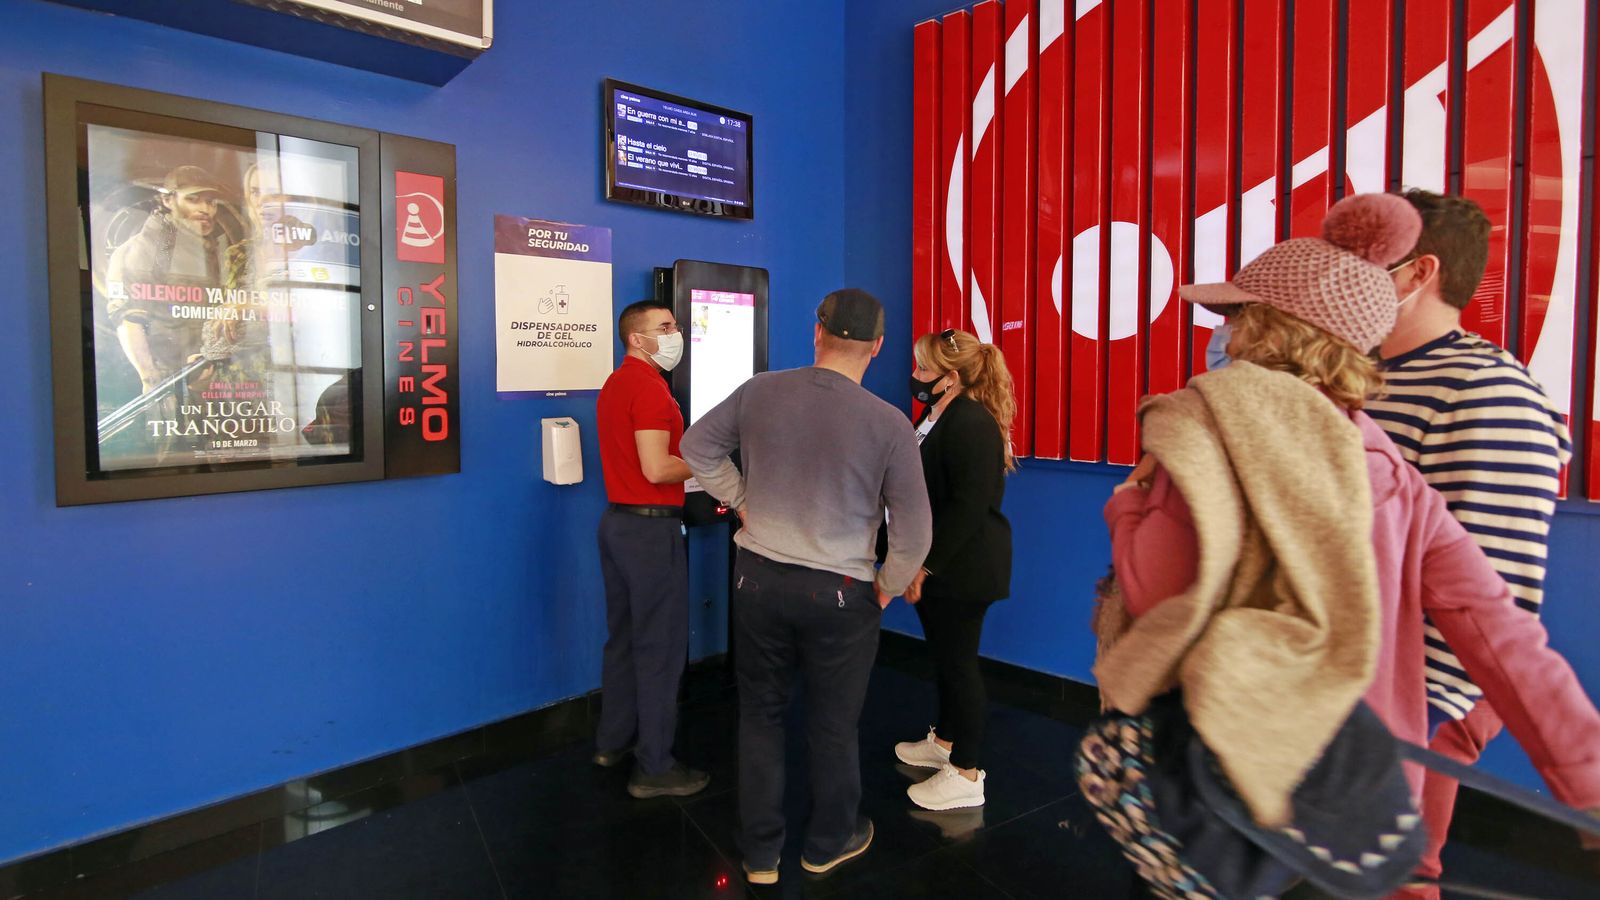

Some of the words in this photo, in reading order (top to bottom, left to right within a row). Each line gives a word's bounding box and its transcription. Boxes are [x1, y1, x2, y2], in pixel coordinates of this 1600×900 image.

[637, 108, 657, 120] guerra
[658, 114, 669, 123] con
[670, 117, 677, 125] mi
[727, 119, 741, 128] 17:38
[627, 137, 646, 148] Hasta
[646, 141, 652, 149] el
[653, 143, 667, 153] cielo
[627, 153, 635, 161] El
[635, 156, 656, 166] verano
[657, 159, 669, 168] que
[528, 228, 551, 239] POR
[554, 232, 568, 240] TU
[528, 238, 589, 252] SEGURIDAD
[108, 282, 128, 300] EL
[131, 283, 203, 303] SILENCIO
[206, 288, 224, 304] YA
[225, 289, 247, 305] NO
[253, 291, 270, 305] ES
[172, 305, 238, 321] COMIENZA
[242, 310, 256, 321] LA
[510, 321, 597, 332] DISPENSADORES
[554, 332, 573, 340] GEL
[398, 287, 415, 426] CINES
[420, 272, 448, 442] YELMO
[181, 405, 202, 415] UN
[206, 401, 284, 418] LUGAR
[148, 418, 295, 438] TRANQUILO
[234, 439, 258, 447] MARZO
